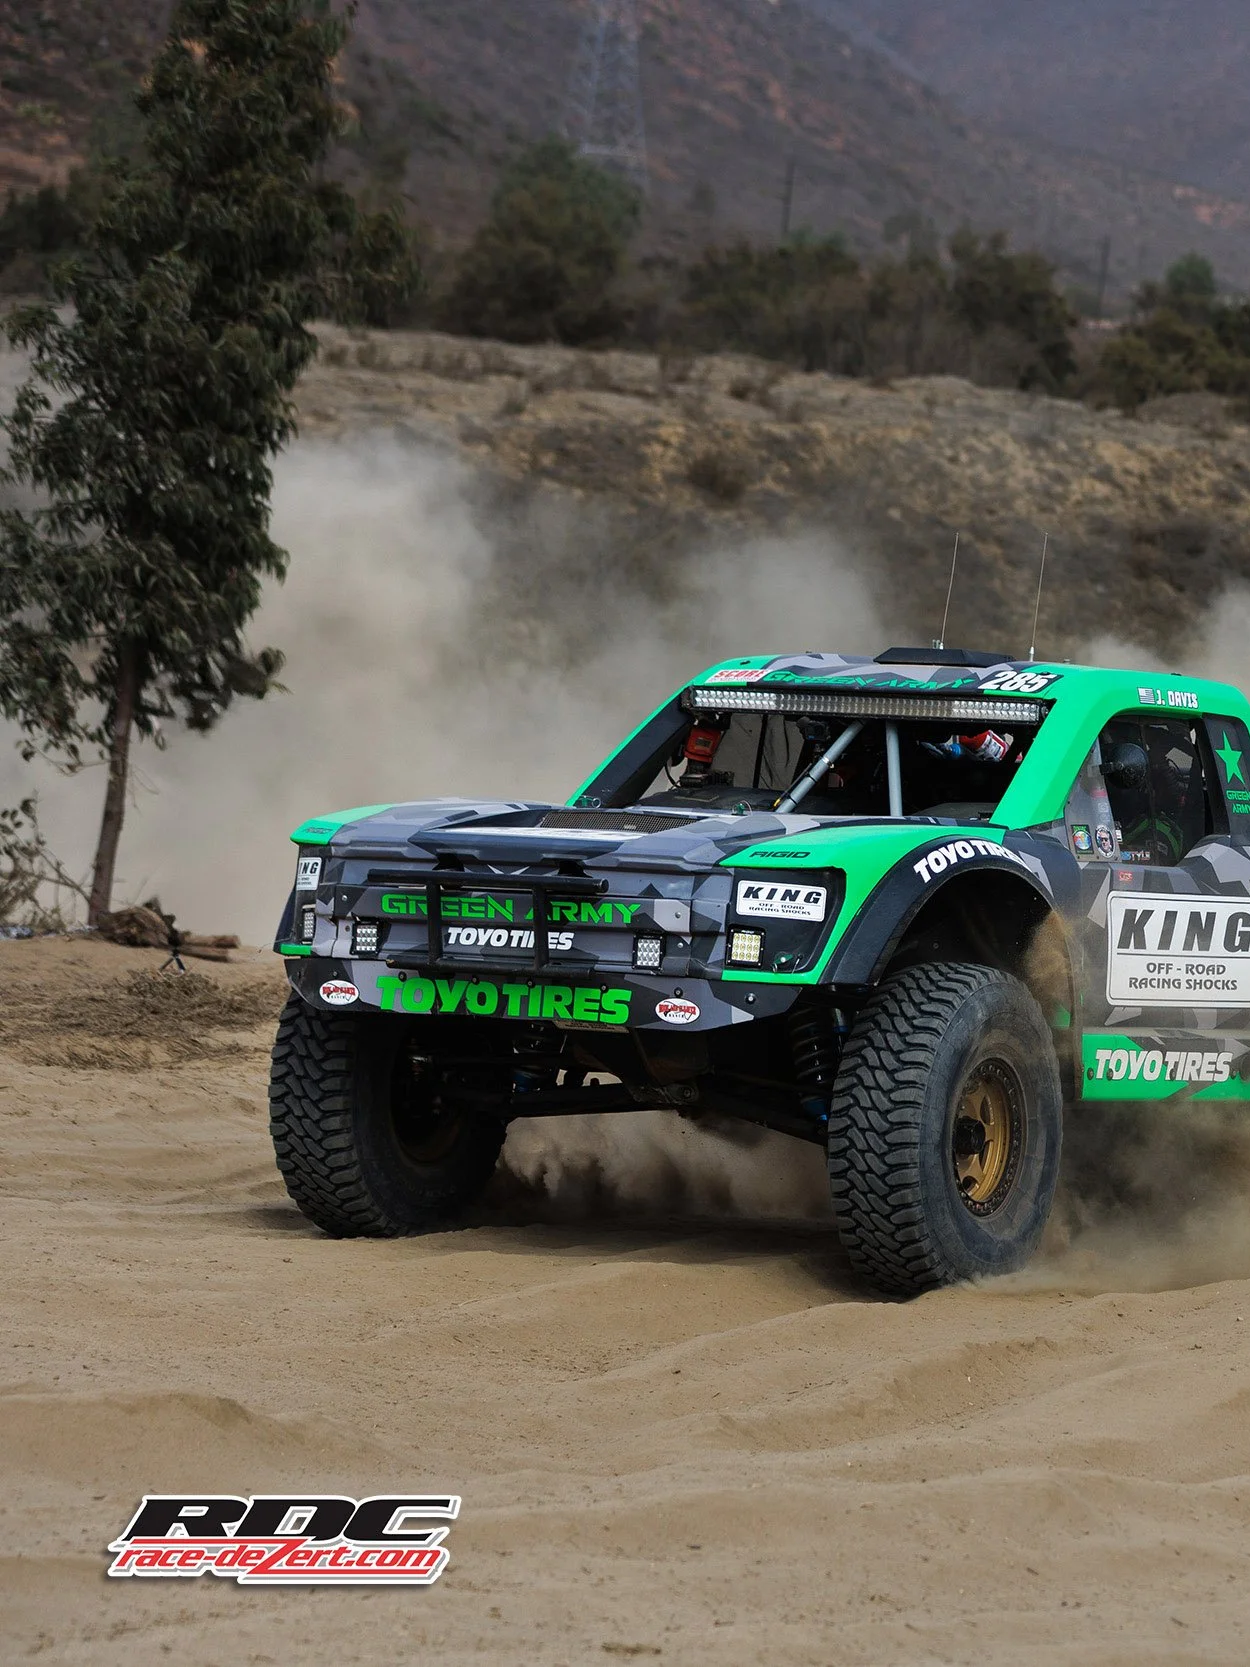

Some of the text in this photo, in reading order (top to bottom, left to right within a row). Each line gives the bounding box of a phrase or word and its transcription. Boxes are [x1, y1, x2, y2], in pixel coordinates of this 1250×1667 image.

[977, 670, 1057, 692] 285
[1167, 690, 1198, 708] DAVIS
[298, 861, 319, 874] ING
[913, 840, 974, 883] TOYO
[742, 886, 822, 904] KING
[382, 893, 513, 922] GREEN
[447, 927, 509, 947] TOYO
[1146, 962, 1173, 975] OFF
[1185, 963, 1226, 975] ROAD
[1128, 977, 1238, 991] RACING SHOCKS
[376, 976, 632, 1024] TOYO TIRES
[1095, 1049, 1234, 1082] TOYO TIRES
